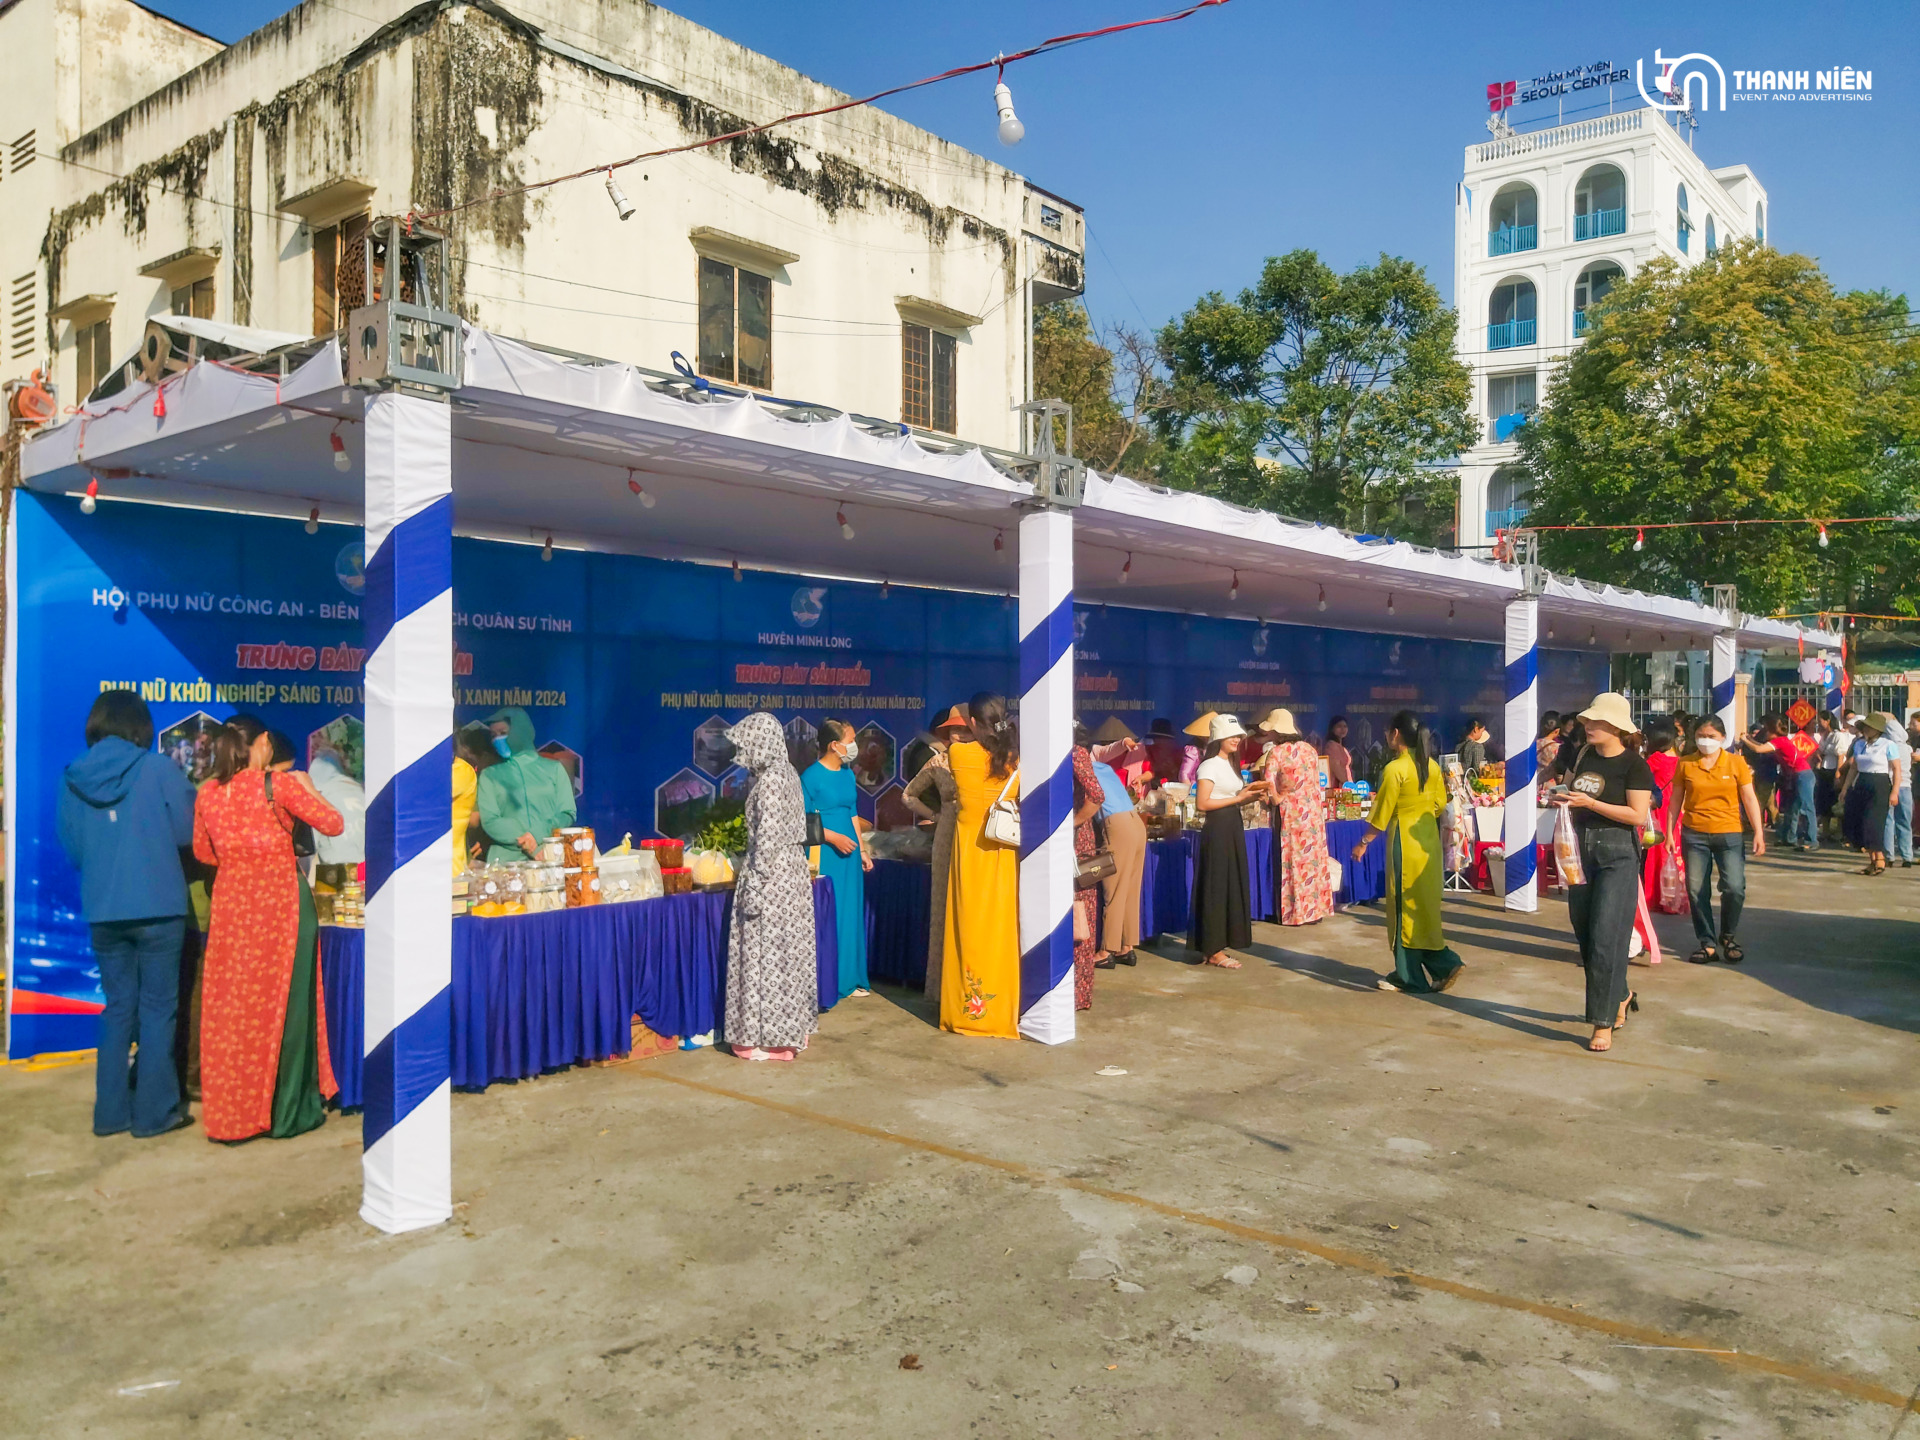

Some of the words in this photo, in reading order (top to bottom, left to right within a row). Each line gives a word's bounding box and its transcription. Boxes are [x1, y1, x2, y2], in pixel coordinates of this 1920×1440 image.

[1521, 83, 1569, 103] SEOUL
[1572, 68, 1630, 91] CENTER
[137, 591, 179, 614] PHỤ
[185, 592, 215, 611] NỮ
[219, 594, 273, 615] CÔNG
[278, 601, 304, 617] AN
[320, 601, 359, 620] BIÊN
[472, 613, 515, 631] QUÂN
[236, 641, 316, 671] TRƯNG
[319, 641, 366, 672] BÀY
[796, 635, 823, 647] MINH
[825, 636, 852, 648] LONG
[141, 677, 167, 702] NỮ
[170, 676, 211, 703] KHỞI
[216, 680, 276, 706] NGHIỆP
[280, 681, 321, 704] SÁNG
[325, 686, 353, 707] TẠO
[465, 688, 500, 706] XANH
[504, 686, 532, 706] NĂM
[535, 690, 566, 707] 2024
[661, 692, 681, 711] PHỤ
[907, 696, 926, 710] 2024
[1574, 778, 1601, 795] one
